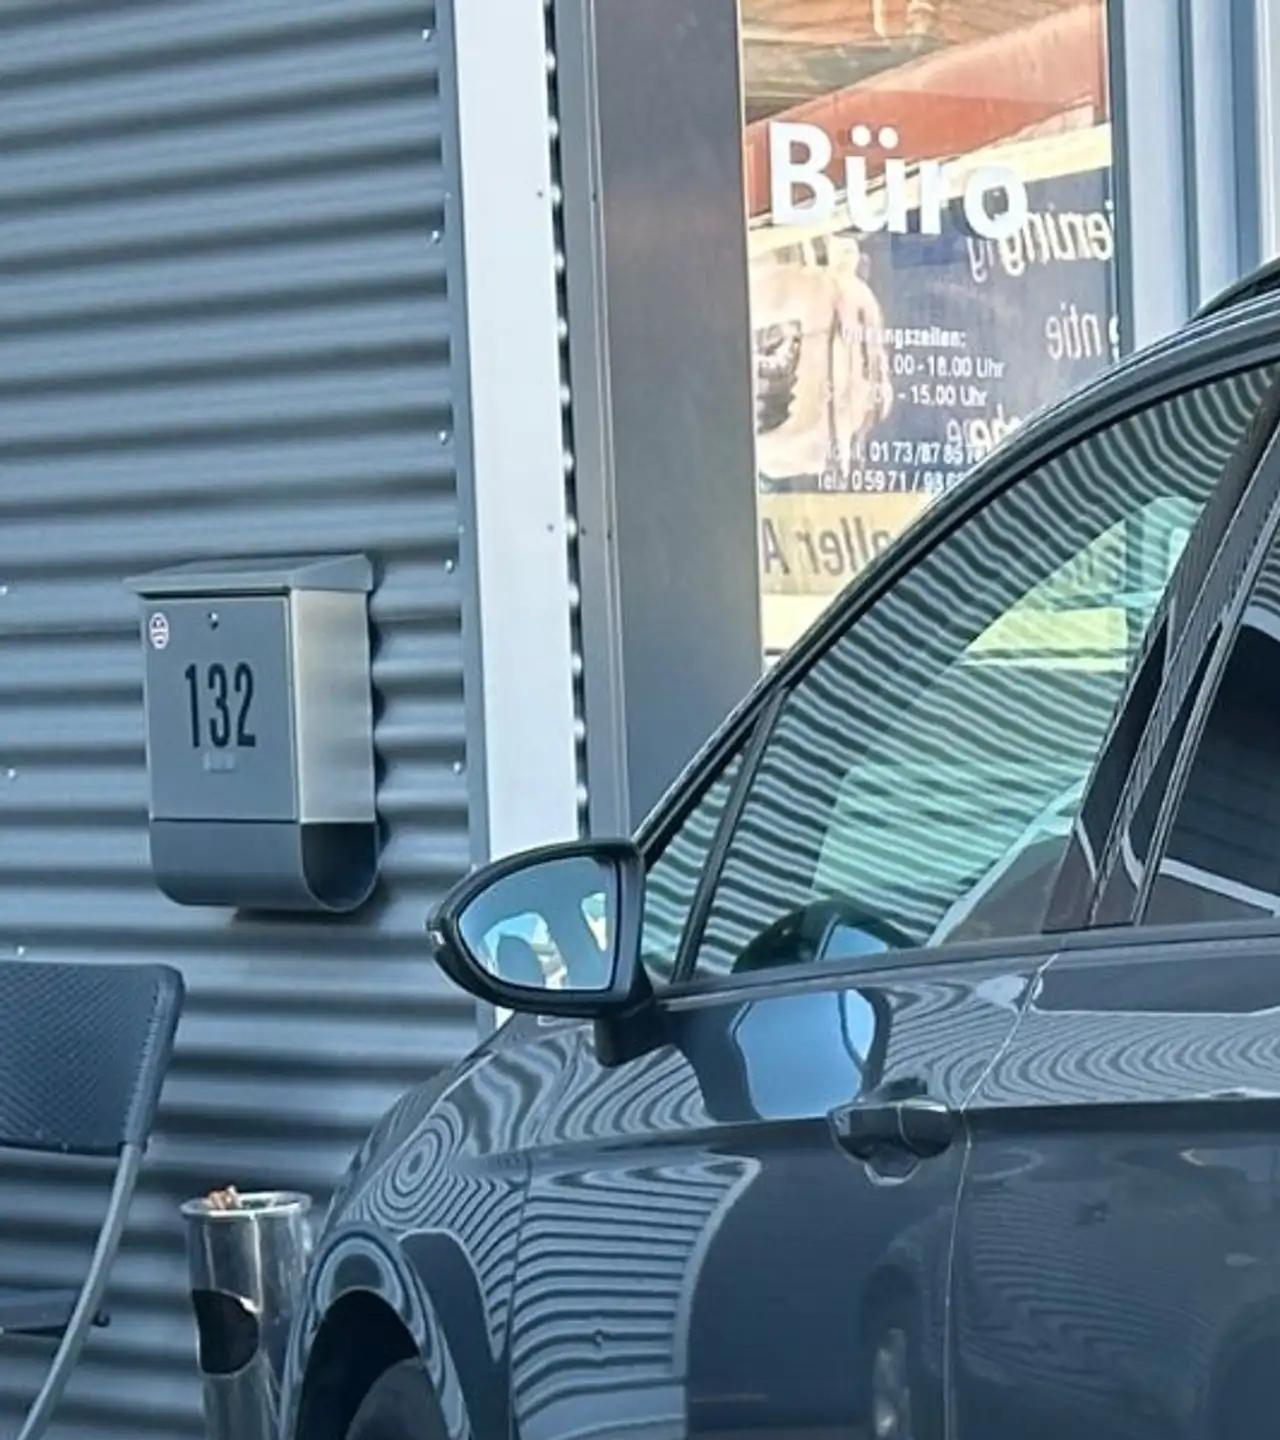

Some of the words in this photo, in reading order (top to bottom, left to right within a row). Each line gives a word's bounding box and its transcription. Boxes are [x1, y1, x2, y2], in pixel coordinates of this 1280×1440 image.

[768, 120, 1028, 241] Büro
[977, 357, 1005, 378] Uhr
[910, 385, 955, 406] 15.00
[961, 386, 987, 407] Uhr
[185, 662, 256, 748] 132
